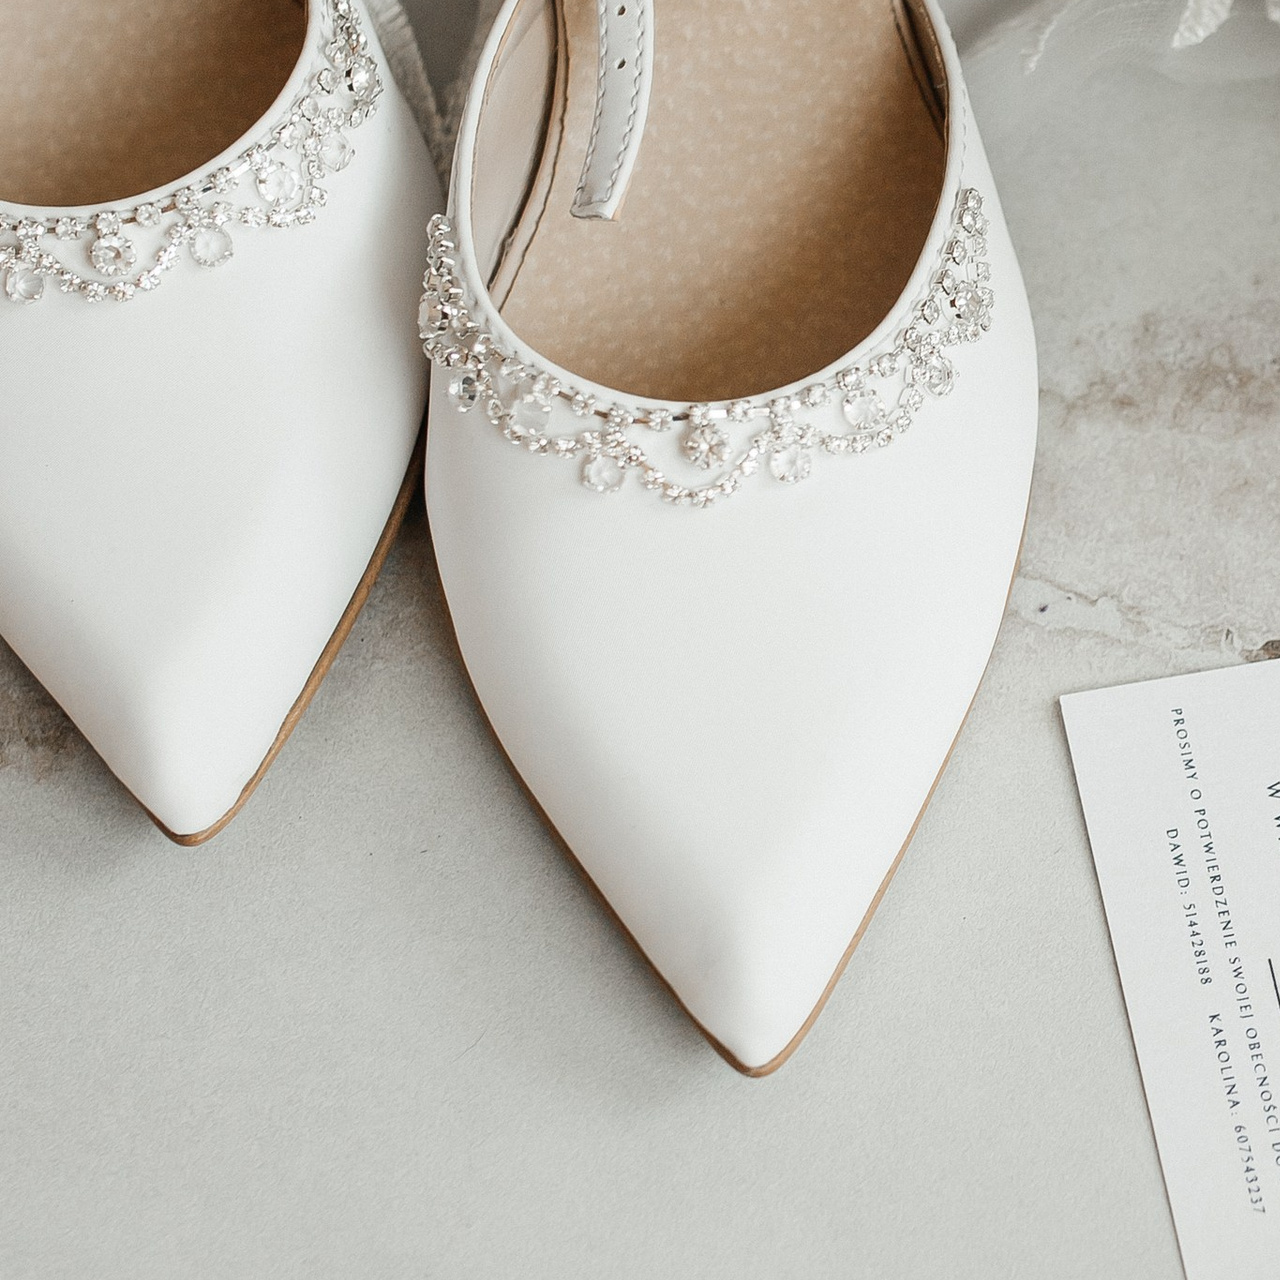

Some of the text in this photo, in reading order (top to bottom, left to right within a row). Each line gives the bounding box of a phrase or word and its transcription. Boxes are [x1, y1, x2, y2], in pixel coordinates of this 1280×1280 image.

[1169, 706, 1200, 781] PROSIMY
[1188, 787, 1203, 802] O
[1192, 807, 1239, 950] POTWIERDZENIE
[1165, 826, 1191, 896] DAWID:
[1181, 902, 1214, 986] 514428188
[1232, 1123, 1267, 1215] 607543237
[1227, 955, 1256, 1020] SWOJEJ
